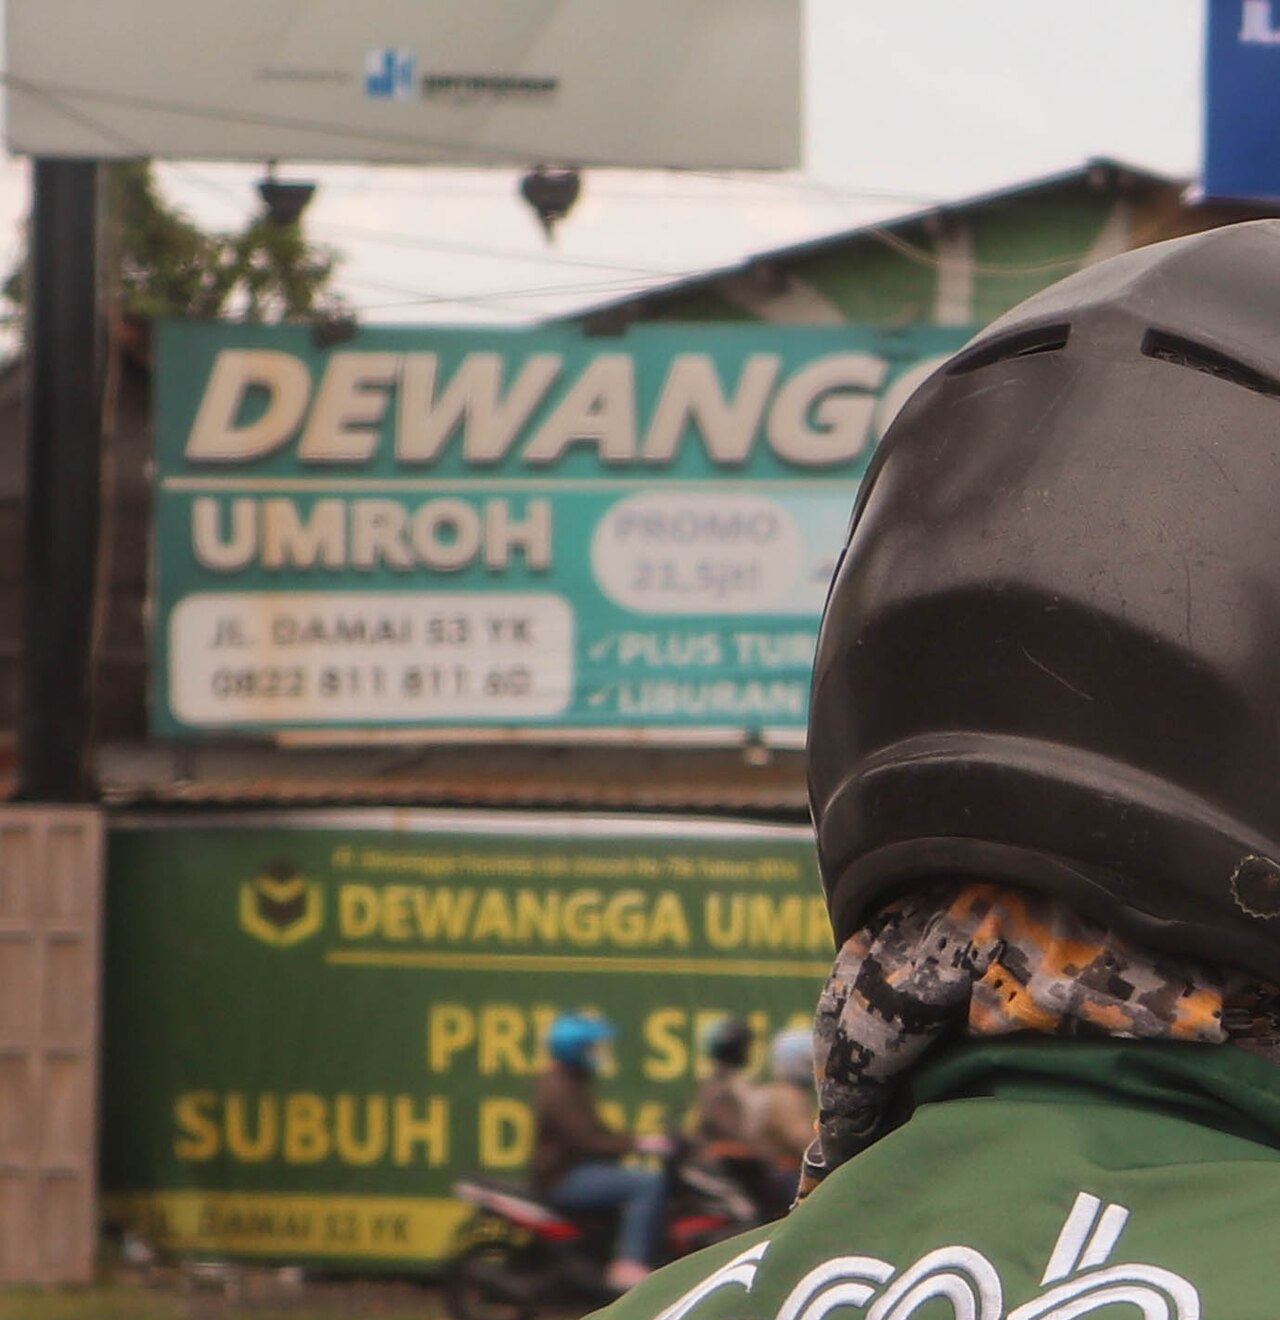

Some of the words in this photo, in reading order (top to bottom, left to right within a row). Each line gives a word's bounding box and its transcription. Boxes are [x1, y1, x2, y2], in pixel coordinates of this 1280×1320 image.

[191, 497, 552, 571] UMROH
[613, 512, 781, 546] PROMO
[271, 617, 412, 647] DAMAI
[617, 632, 721, 665] PLUS
[338, 882, 690, 950] DEWANGGA
[173, 1090, 449, 1168] SUBUH
